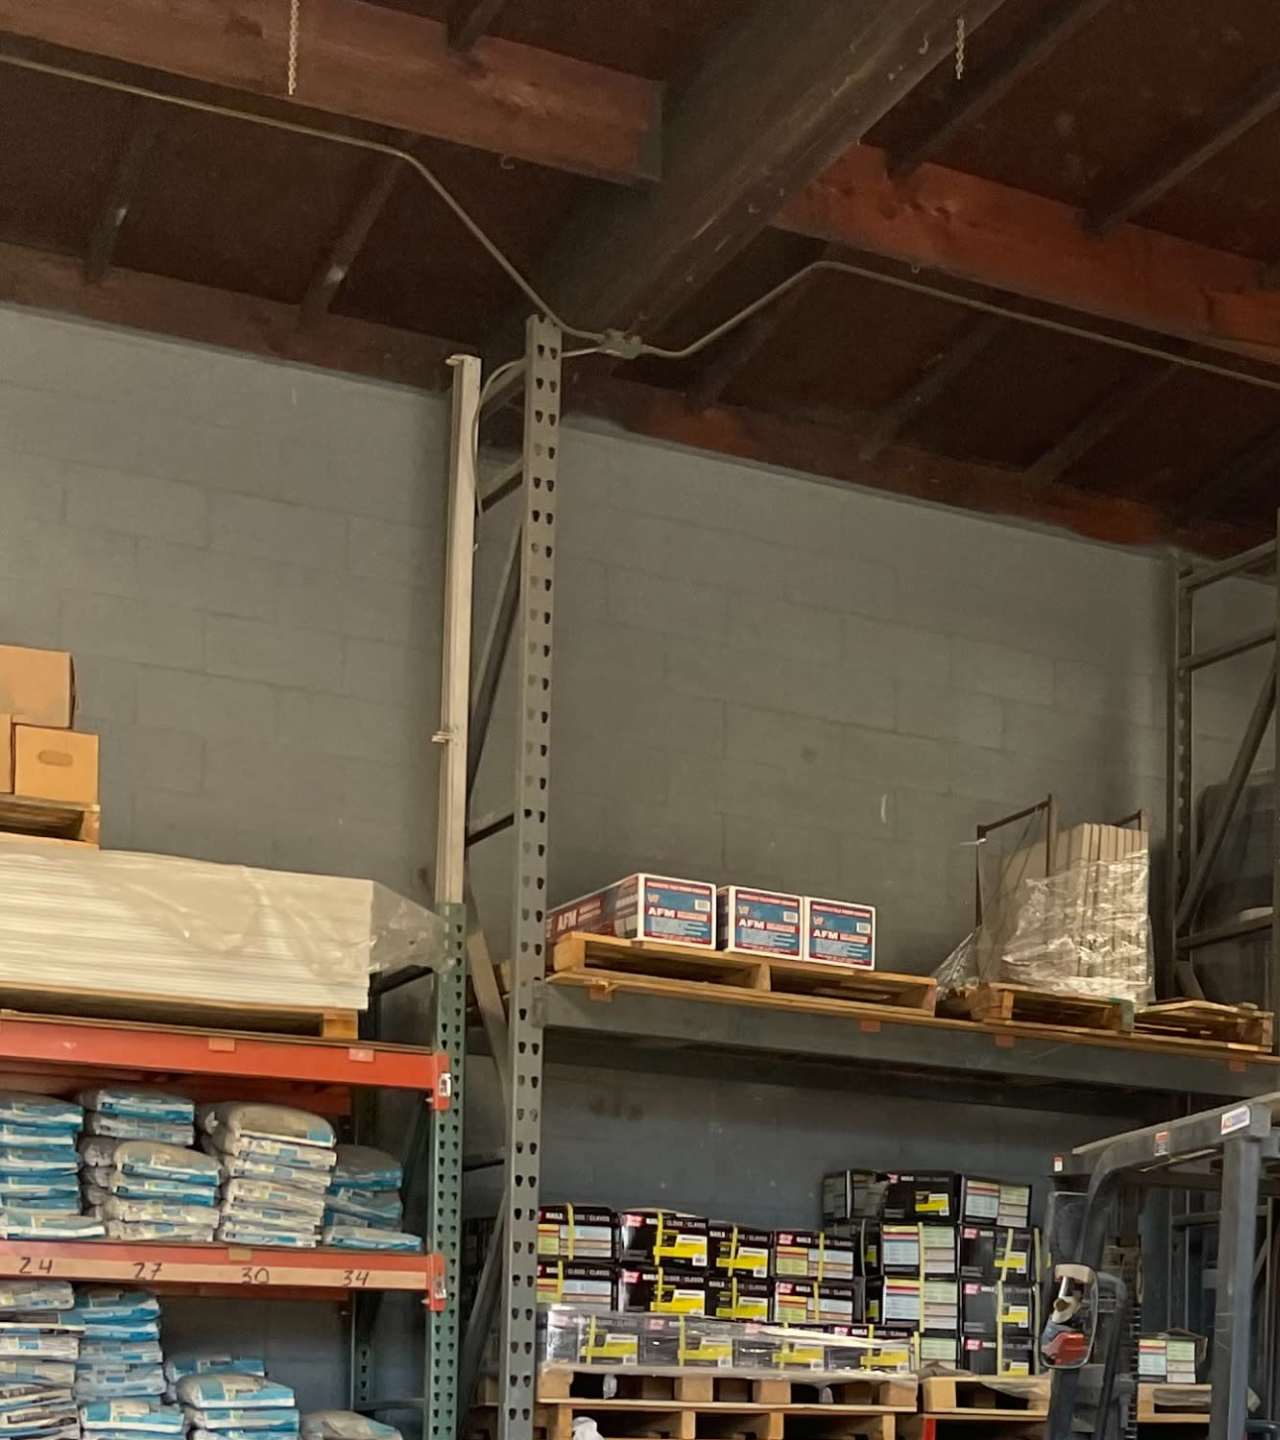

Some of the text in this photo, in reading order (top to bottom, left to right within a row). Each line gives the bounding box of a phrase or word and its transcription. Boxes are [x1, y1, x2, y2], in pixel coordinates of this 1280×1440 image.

[557, 909, 578, 932] AFM
[648, 907, 675, 919] AFM
[739, 919, 766, 930] AFM
[813, 929, 840, 940] AFM
[18, 1256, 53, 1275] 24
[133, 1262, 163, 1280] 27
[241, 1267, 270, 1287] 30
[343, 1269, 370, 1288] 34
